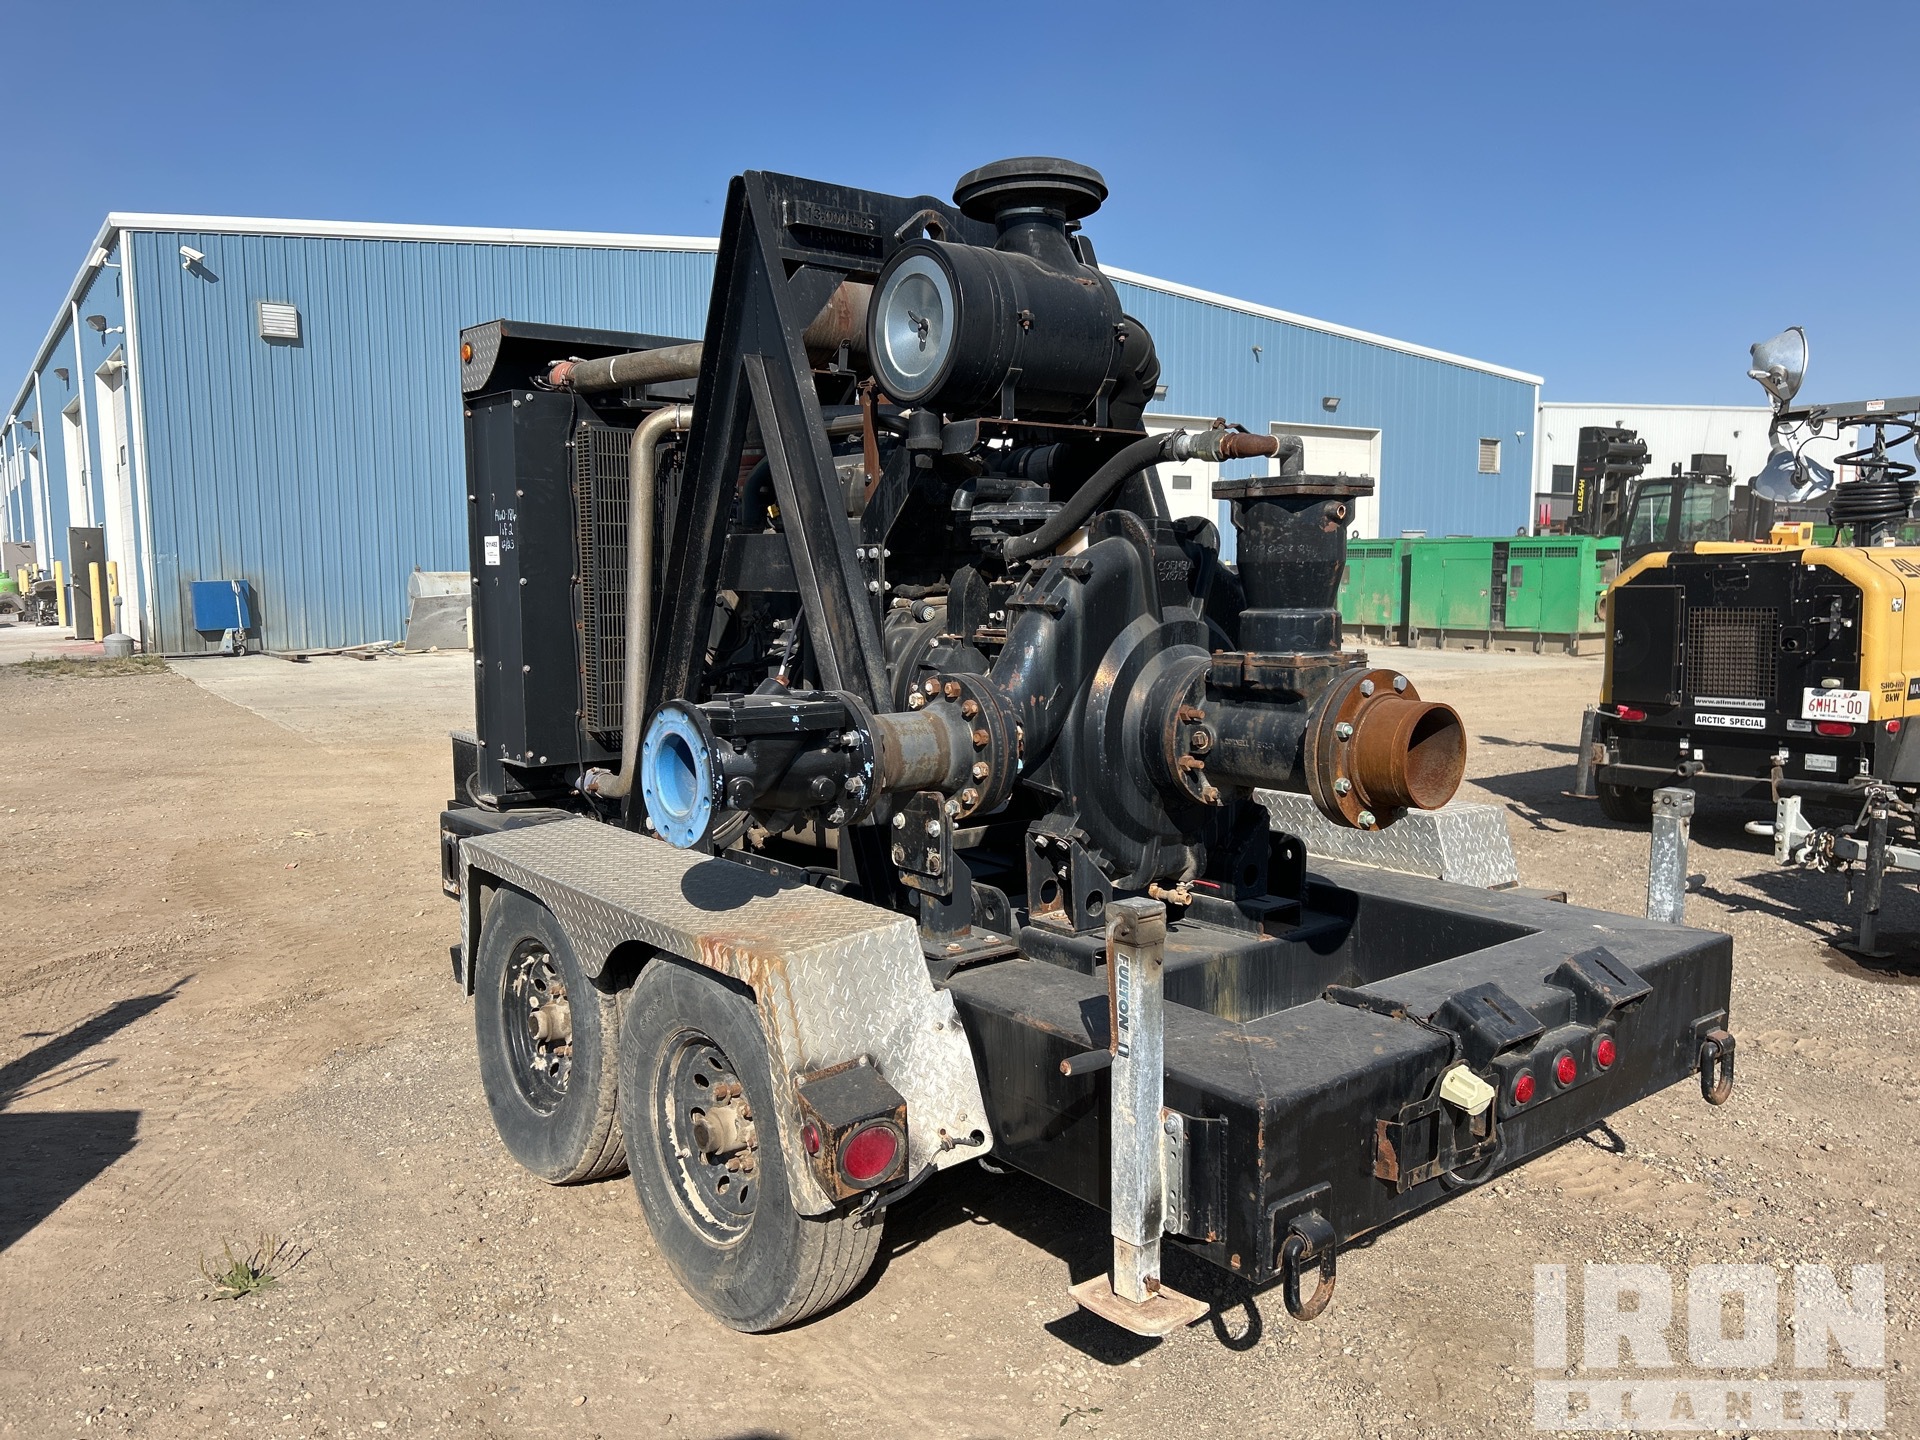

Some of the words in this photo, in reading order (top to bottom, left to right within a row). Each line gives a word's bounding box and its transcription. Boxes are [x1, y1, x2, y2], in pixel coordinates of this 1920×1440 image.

[1577, 479, 1585, 512] HYSTER
[1909, 683, 1920, 695] MA
[1885, 692, 1900, 703] 8kW
[1808, 698, 1863, 715] 6MH1-00
[1696, 715, 1726, 725] ARCTIC
[1729, 717, 1764, 728] SPECIAL
[1117, 952, 1131, 1032] FULTON
